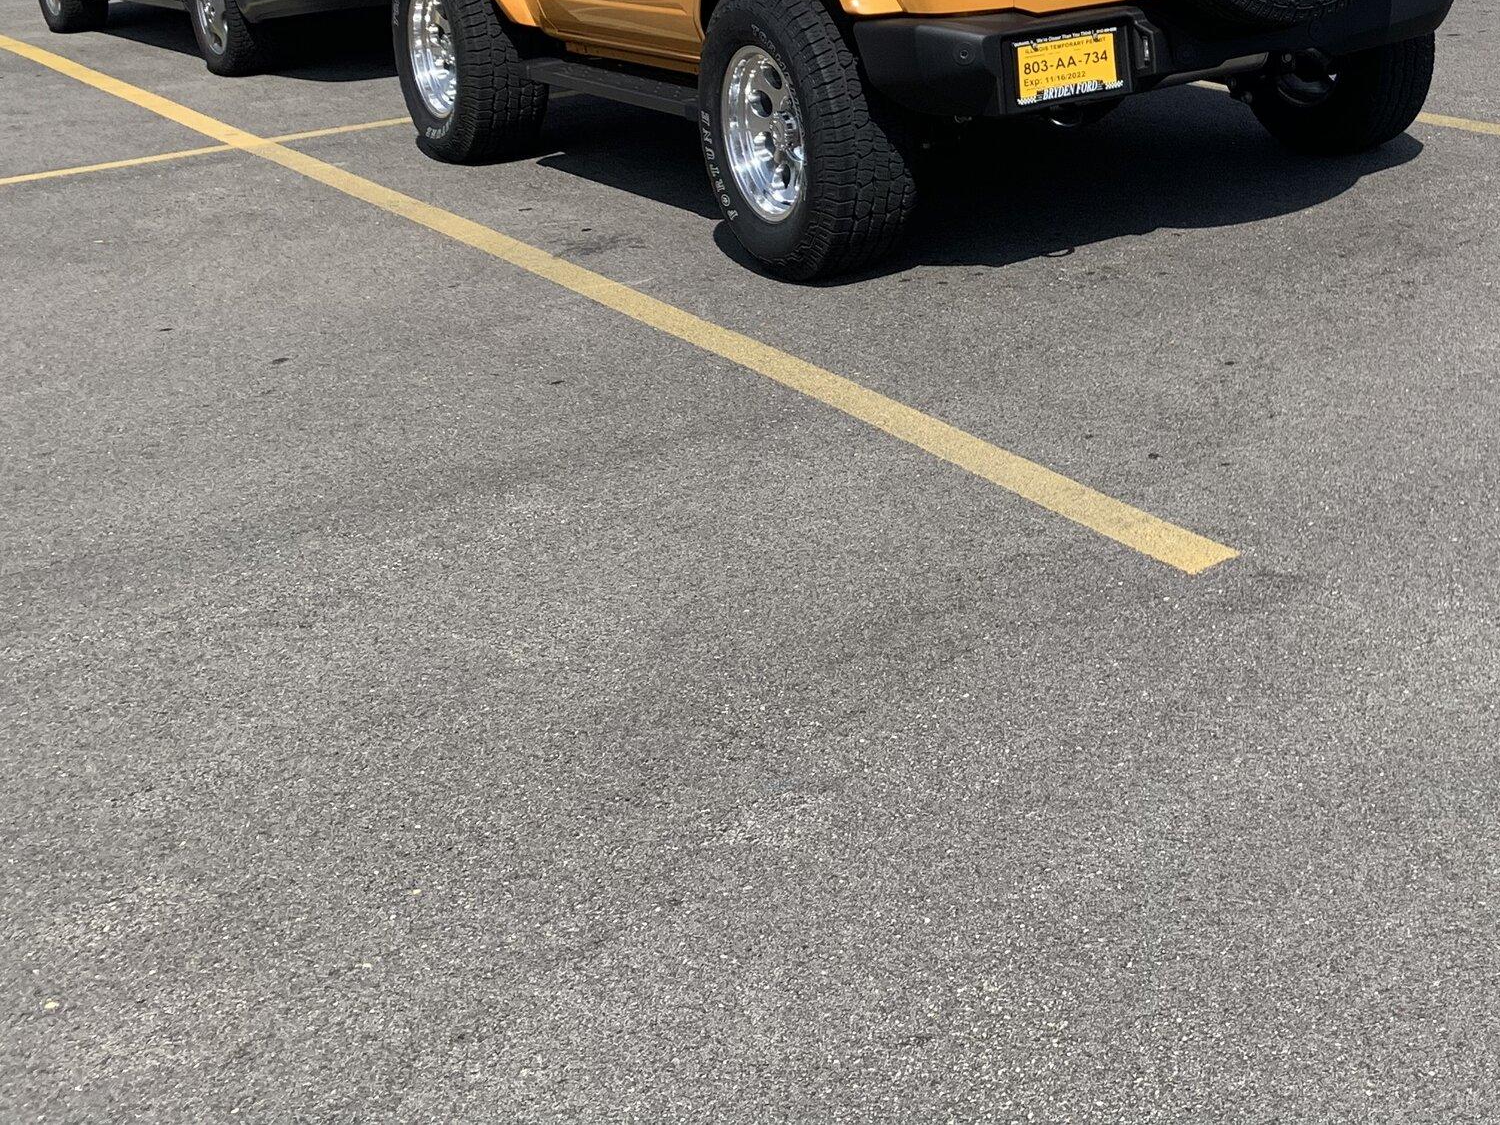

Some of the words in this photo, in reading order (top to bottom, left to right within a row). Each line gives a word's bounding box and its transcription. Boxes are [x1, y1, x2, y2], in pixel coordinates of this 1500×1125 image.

[1050, 39, 1084, 50] TEMPORARY
[1023, 51, 1108, 75] 803-AA-734
[1023, 78, 1042, 88] Exp:
[1043, 83, 1076, 100] BRYDEN
[1075, 80, 1098, 94] FORD
[700, 110, 739, 221] FORTUNE
